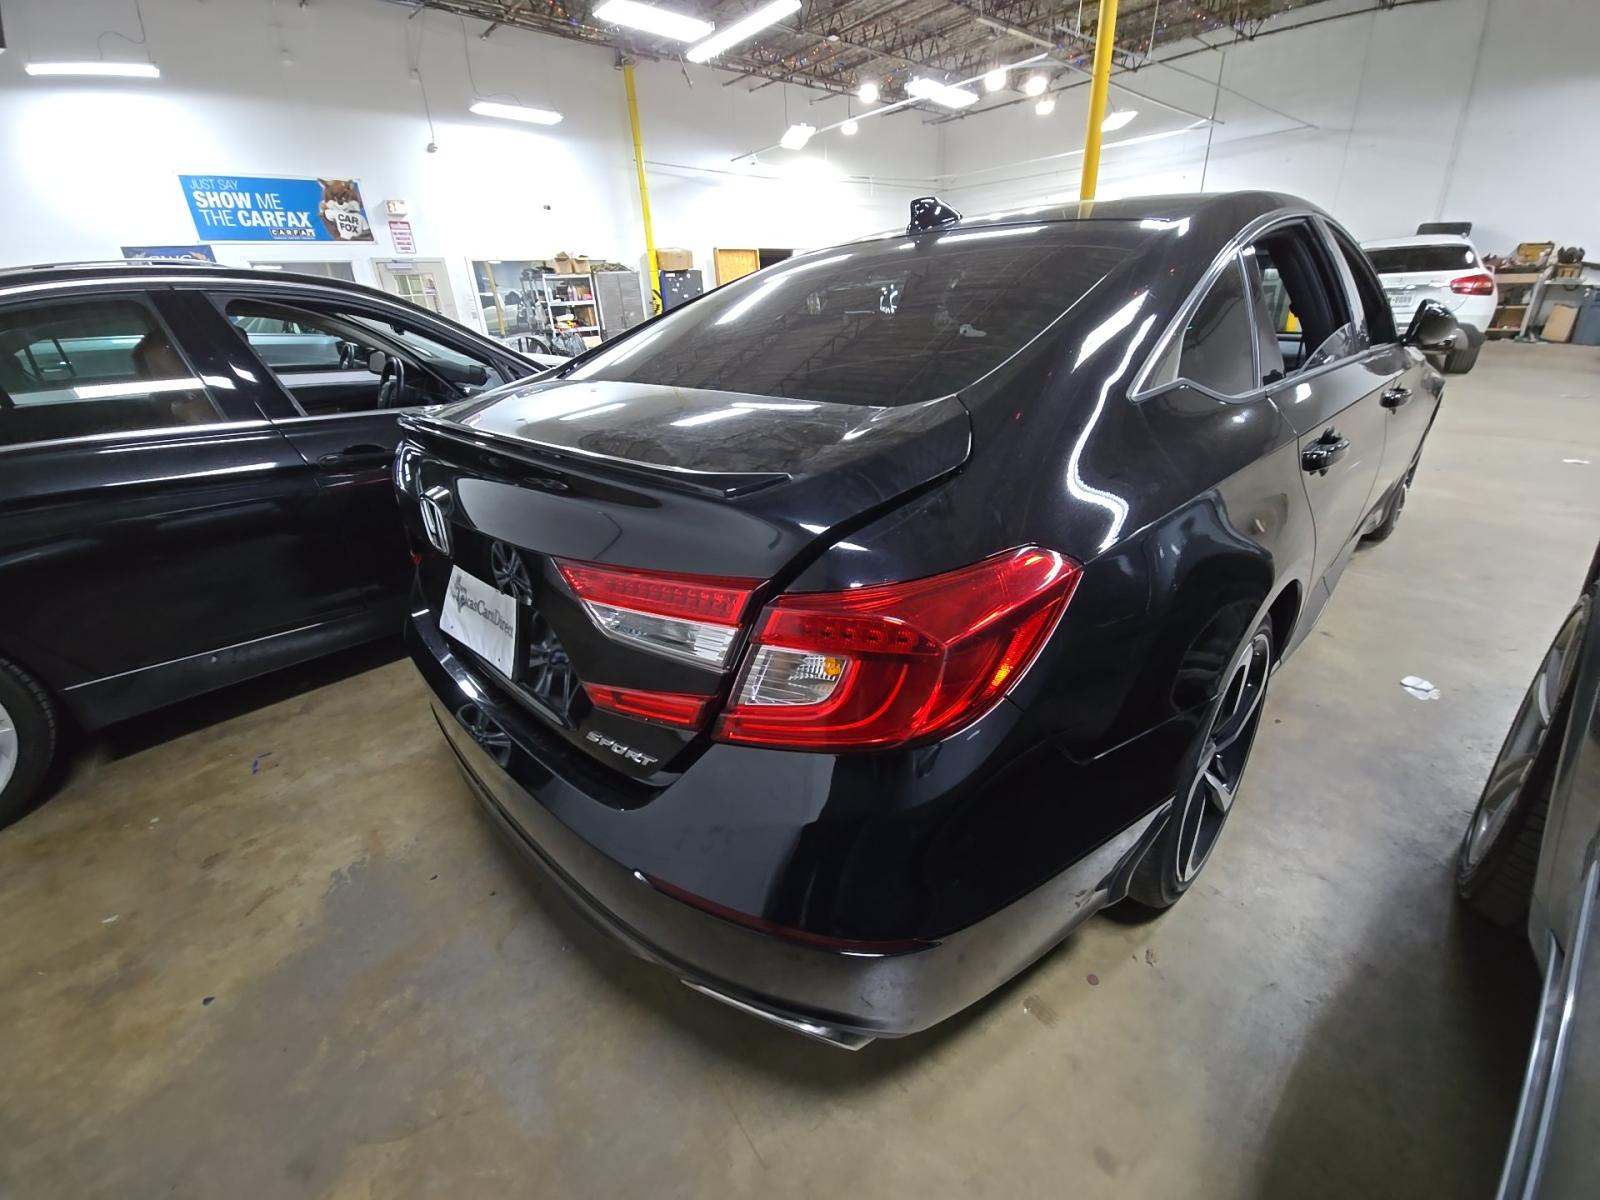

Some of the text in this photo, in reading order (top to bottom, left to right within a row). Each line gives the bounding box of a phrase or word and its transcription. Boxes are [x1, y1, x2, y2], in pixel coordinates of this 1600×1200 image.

[191, 178, 238, 190] JUST SAY
[193, 191, 283, 210] SHOW ME
[201, 209, 313, 228] THE CARFAX
[338, 213, 359, 226] CAR
[272, 228, 316, 237] CARFAX
[340, 222, 358, 235] FOX
[586, 731, 659, 765] SPORT
